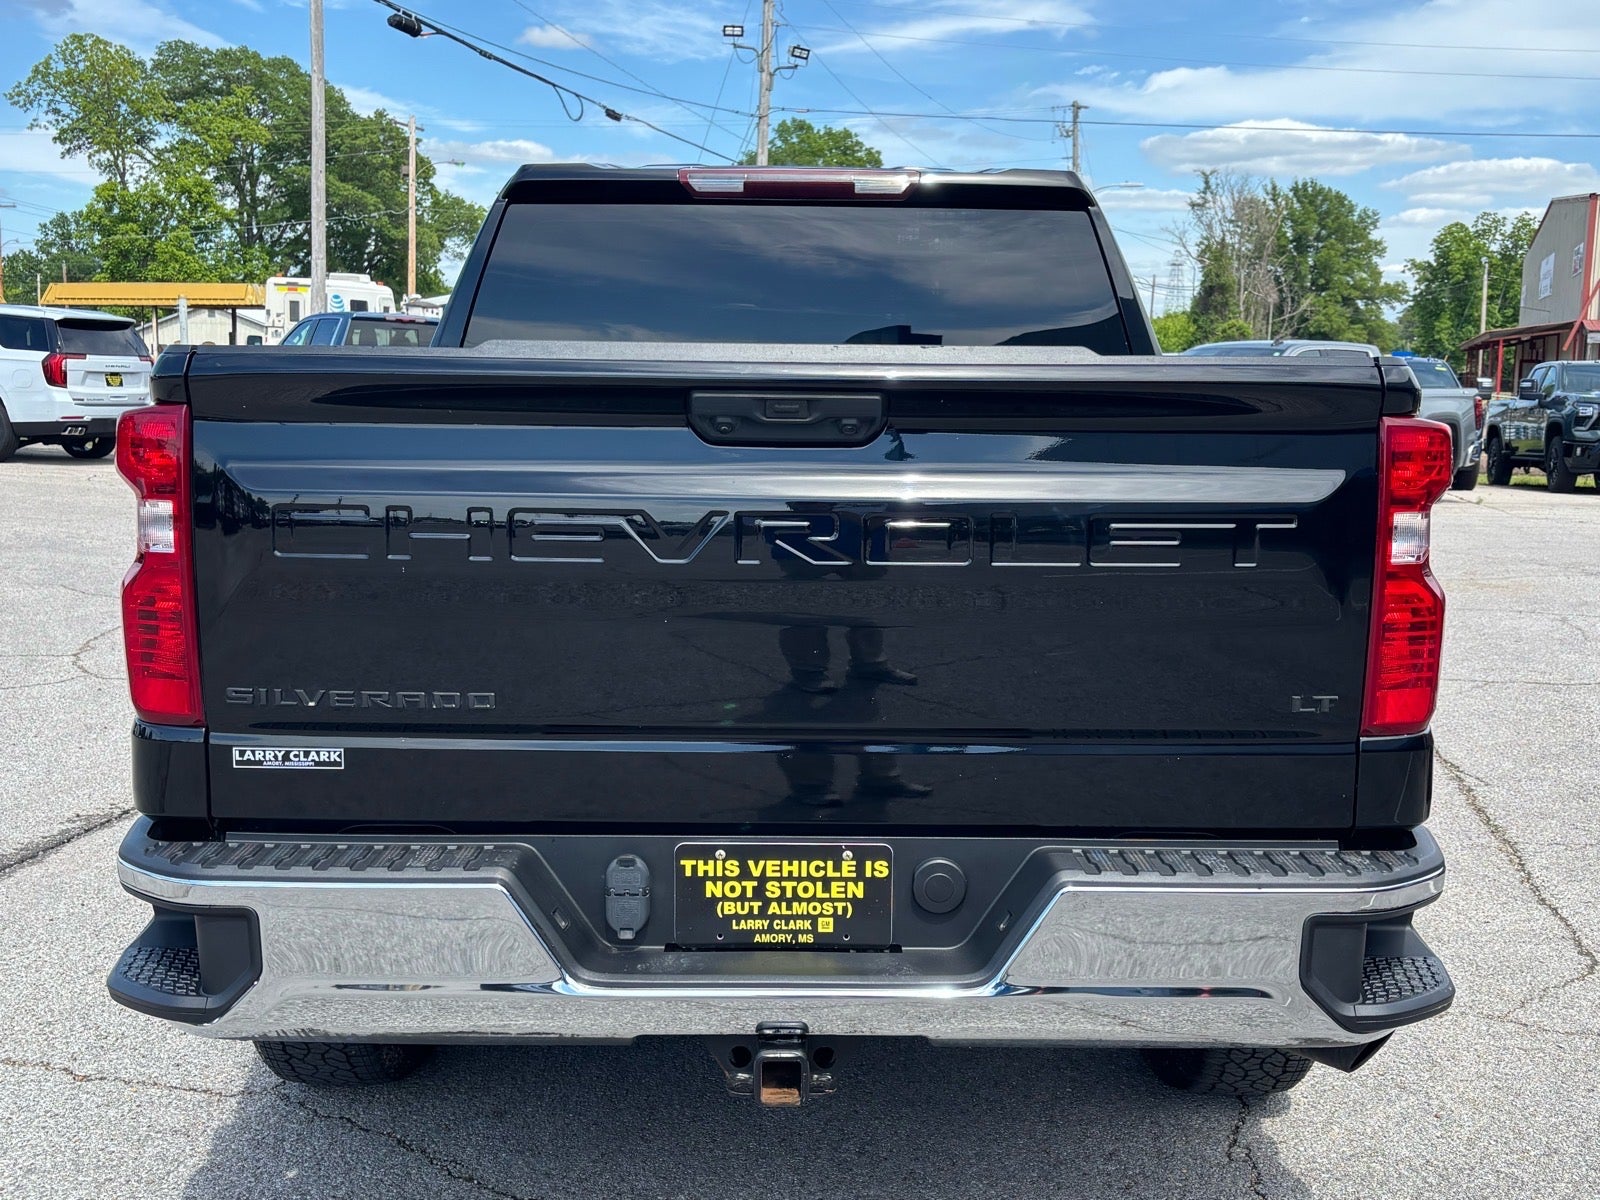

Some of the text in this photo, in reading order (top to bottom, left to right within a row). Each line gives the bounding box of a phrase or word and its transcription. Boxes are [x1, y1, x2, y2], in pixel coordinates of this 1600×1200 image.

[271, 503, 1298, 567] CHEVROLET
[225, 686, 496, 709] SILVERADO
[1291, 695, 1339, 713] LT
[234, 749, 342, 762] LARRY CLARK
[680, 859, 889, 878] THIS VEHICLE IS
[705, 881, 864, 899] NOT STOLEN
[716, 901, 853, 919] (BUT ALMOST)
[732, 919, 812, 930] LARRY CLARK
[753, 933, 814, 944] AMORY, MS
